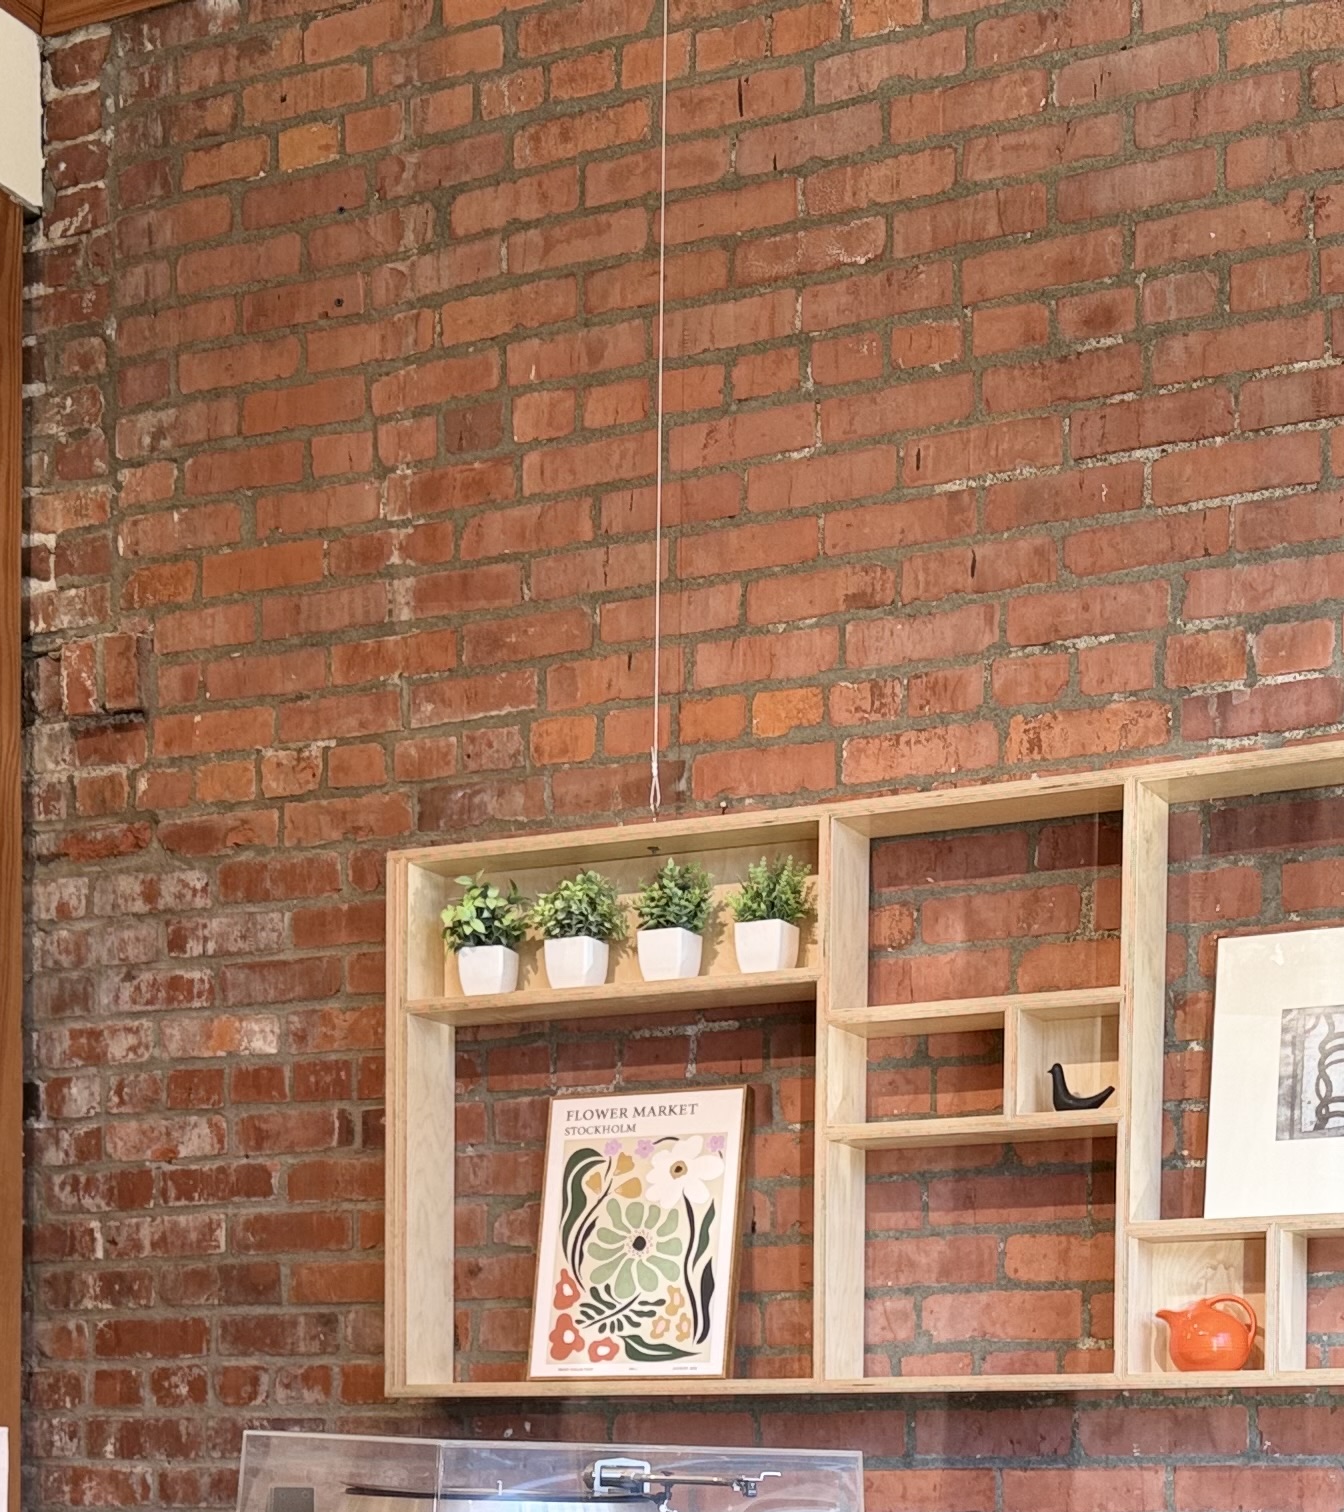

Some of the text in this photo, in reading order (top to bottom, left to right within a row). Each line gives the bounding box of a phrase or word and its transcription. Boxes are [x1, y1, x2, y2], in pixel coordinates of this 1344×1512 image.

[565, 1102, 699, 1122] FLOWER MARKET
[564, 1123, 637, 1136] STOCKHOLM
